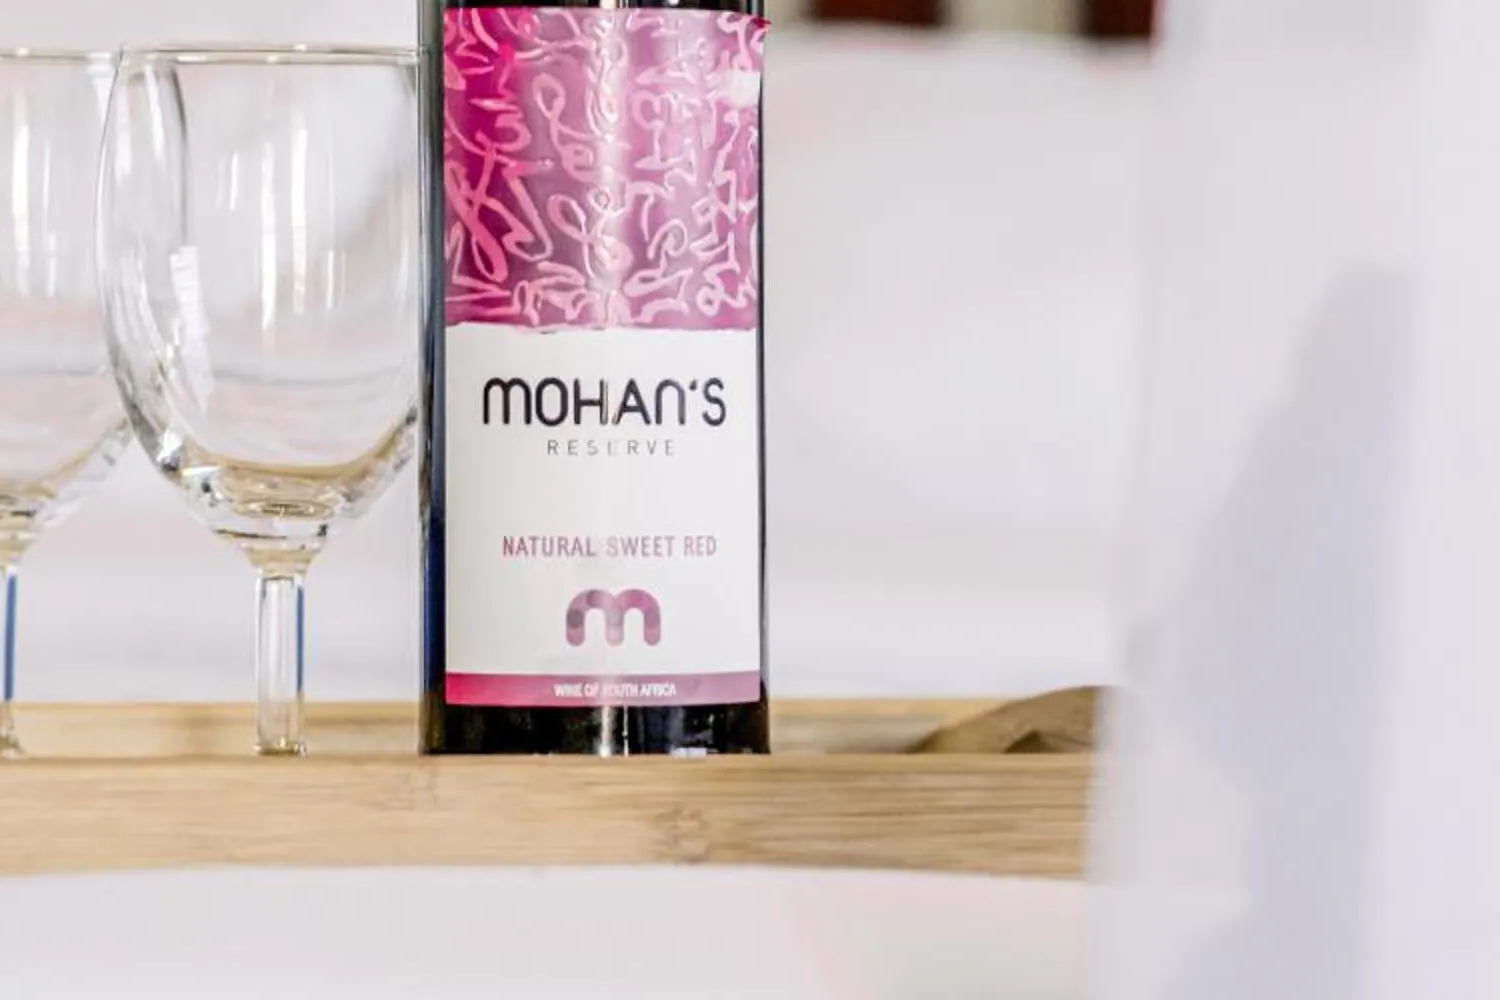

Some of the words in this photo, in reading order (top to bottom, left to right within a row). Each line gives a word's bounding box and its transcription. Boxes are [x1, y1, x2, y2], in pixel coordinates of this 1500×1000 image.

[483, 377, 727, 427] MOHAN'S
[503, 535, 596, 557] NATURAL
[604, 535, 676, 557] SWEET
[683, 535, 717, 557] RED
[553, 683, 582, 697] WINE
[584, 683, 599, 697] OF
[640, 682, 677, 697] AFRICA
